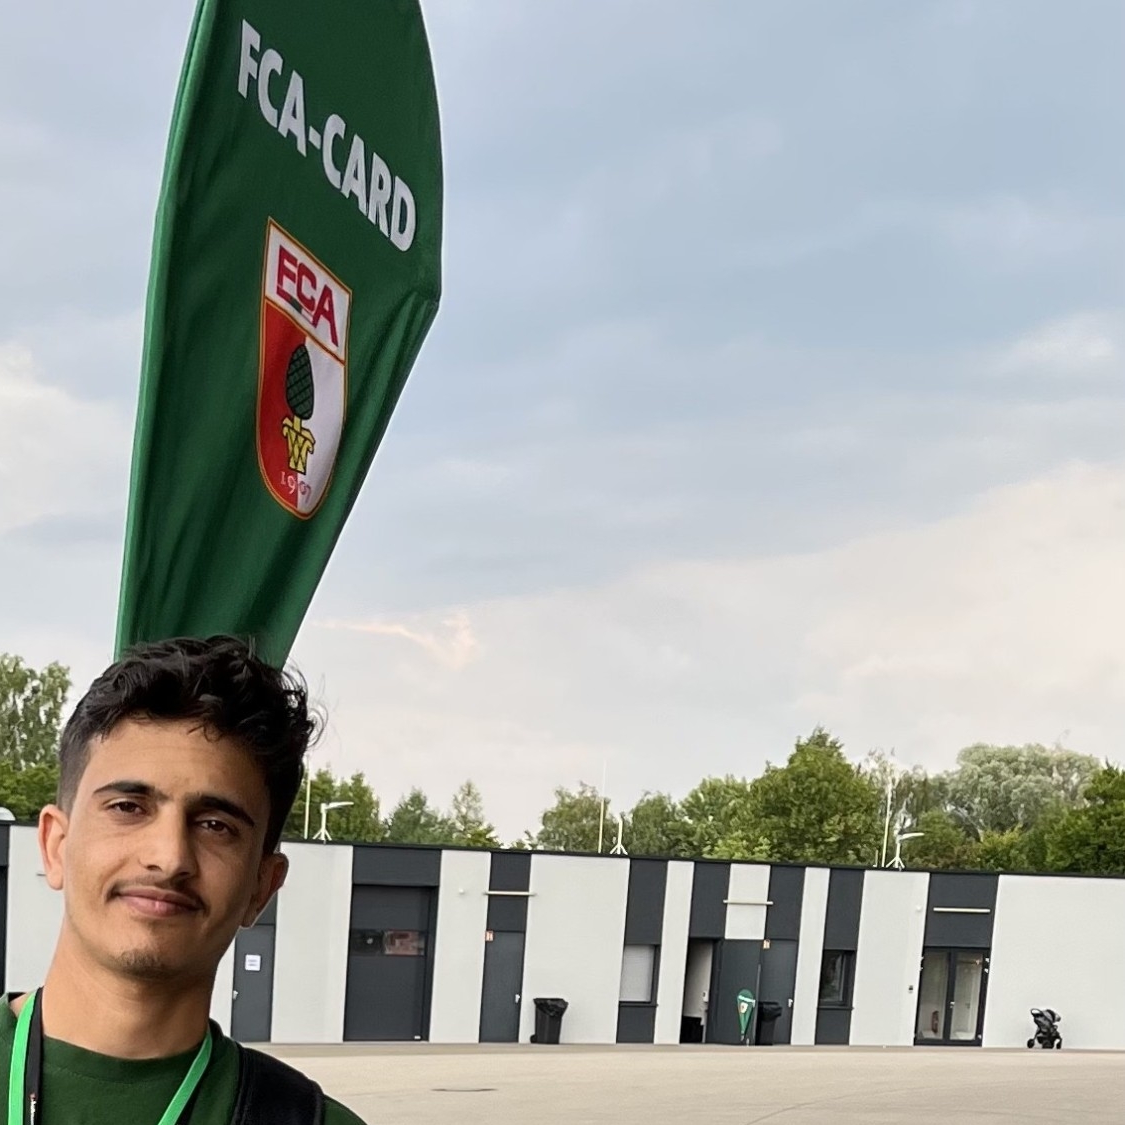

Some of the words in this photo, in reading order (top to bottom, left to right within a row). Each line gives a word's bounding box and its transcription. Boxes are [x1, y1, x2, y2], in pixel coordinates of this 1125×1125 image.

[237, 19, 417, 252] FCA-CARD
[276, 244, 340, 347] FCA
[280, 471, 312, 503] 1907
